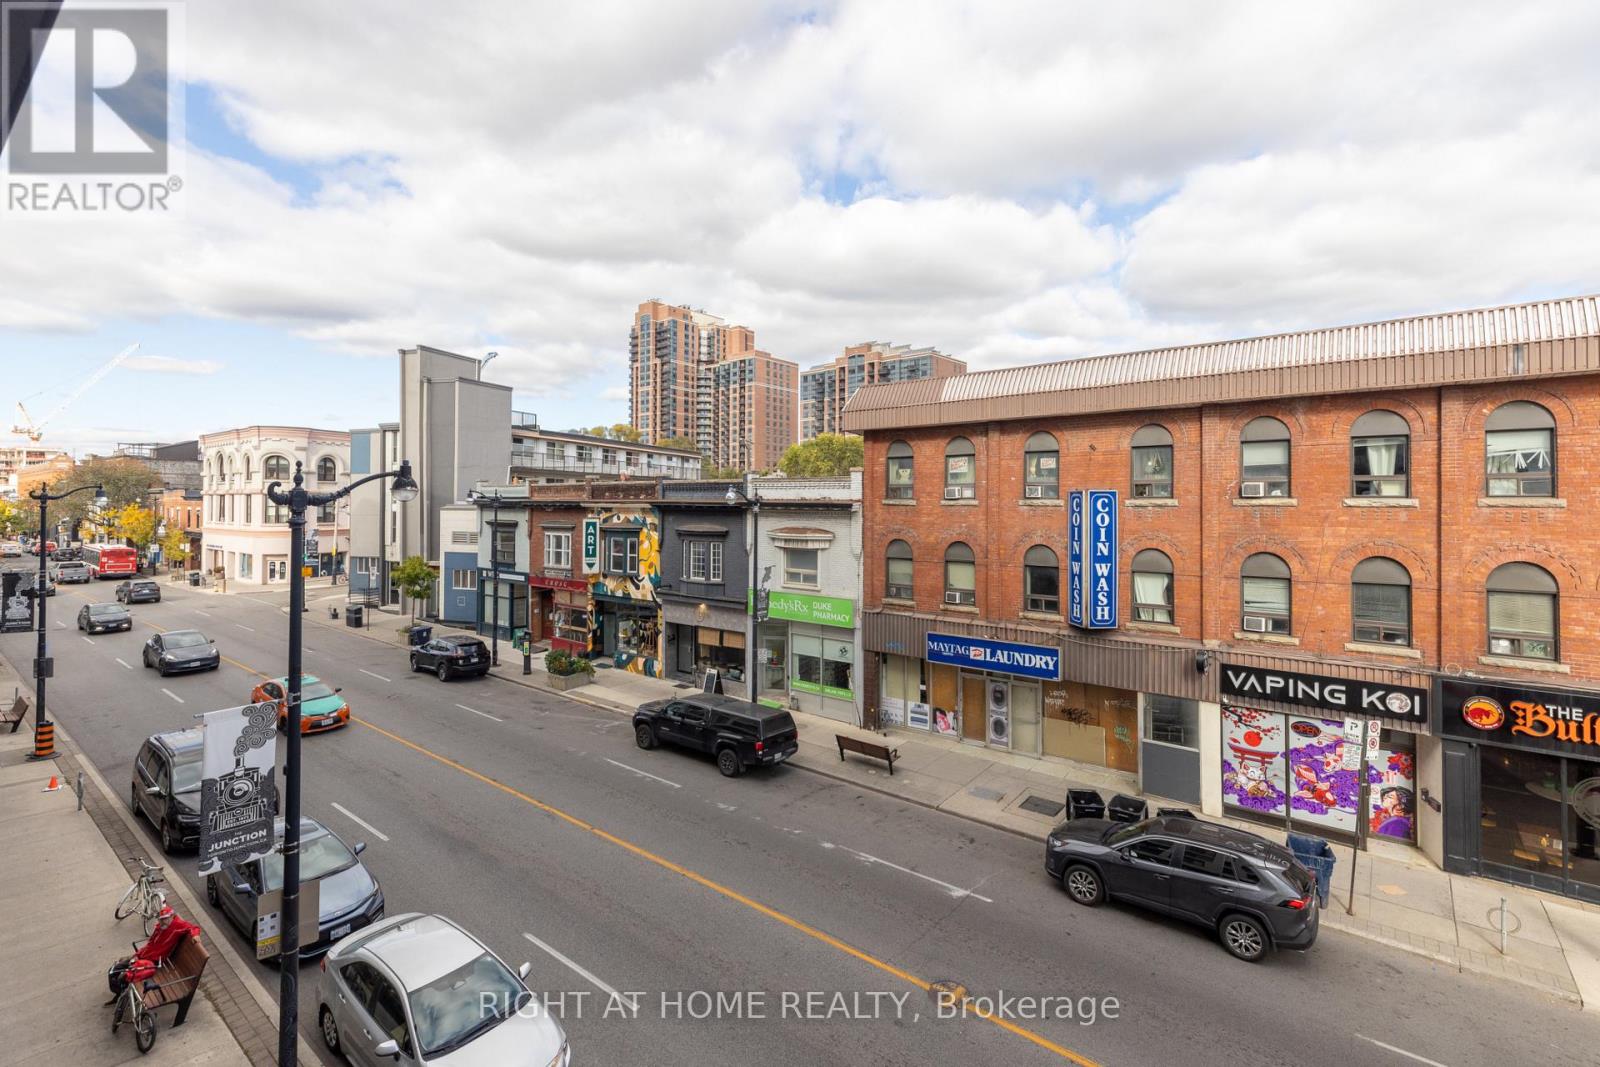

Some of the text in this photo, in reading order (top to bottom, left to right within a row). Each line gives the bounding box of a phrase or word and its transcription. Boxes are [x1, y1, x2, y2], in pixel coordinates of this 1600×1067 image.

[587, 525, 595, 555] ART
[1071, 497, 1081, 618] COIN WASH
[1094, 497, 1112, 620] COIN WASH
[812, 601, 832, 611] DUKE
[812, 610, 850, 622] PHARMACY
[928, 640, 1058, 671] MAYTAG LAUNDRY
[1226, 670, 1420, 716] VAPING KOI
[1545, 704, 1584, 721] THE
[1292, 723, 1320, 737] OPEN
[208, 828, 268, 853] JUNCTION
